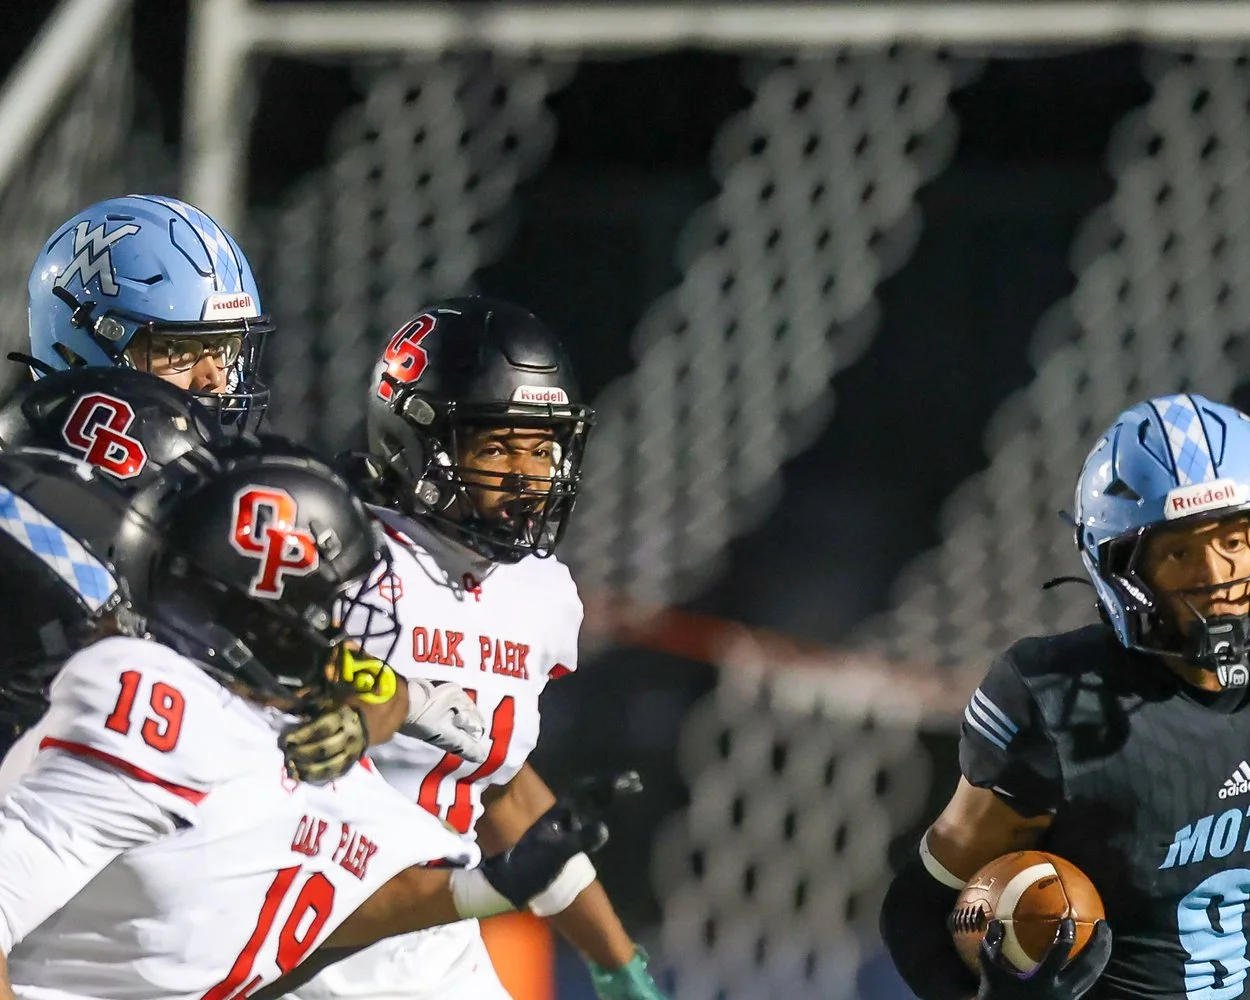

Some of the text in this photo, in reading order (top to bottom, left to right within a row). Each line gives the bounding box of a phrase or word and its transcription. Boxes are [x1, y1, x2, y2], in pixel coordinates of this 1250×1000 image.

[1172, 484, 1236, 511] Riddell
[229, 484, 319, 600] OP
[412, 626, 531, 680] OAK PARK
[104, 670, 186, 753] 19
